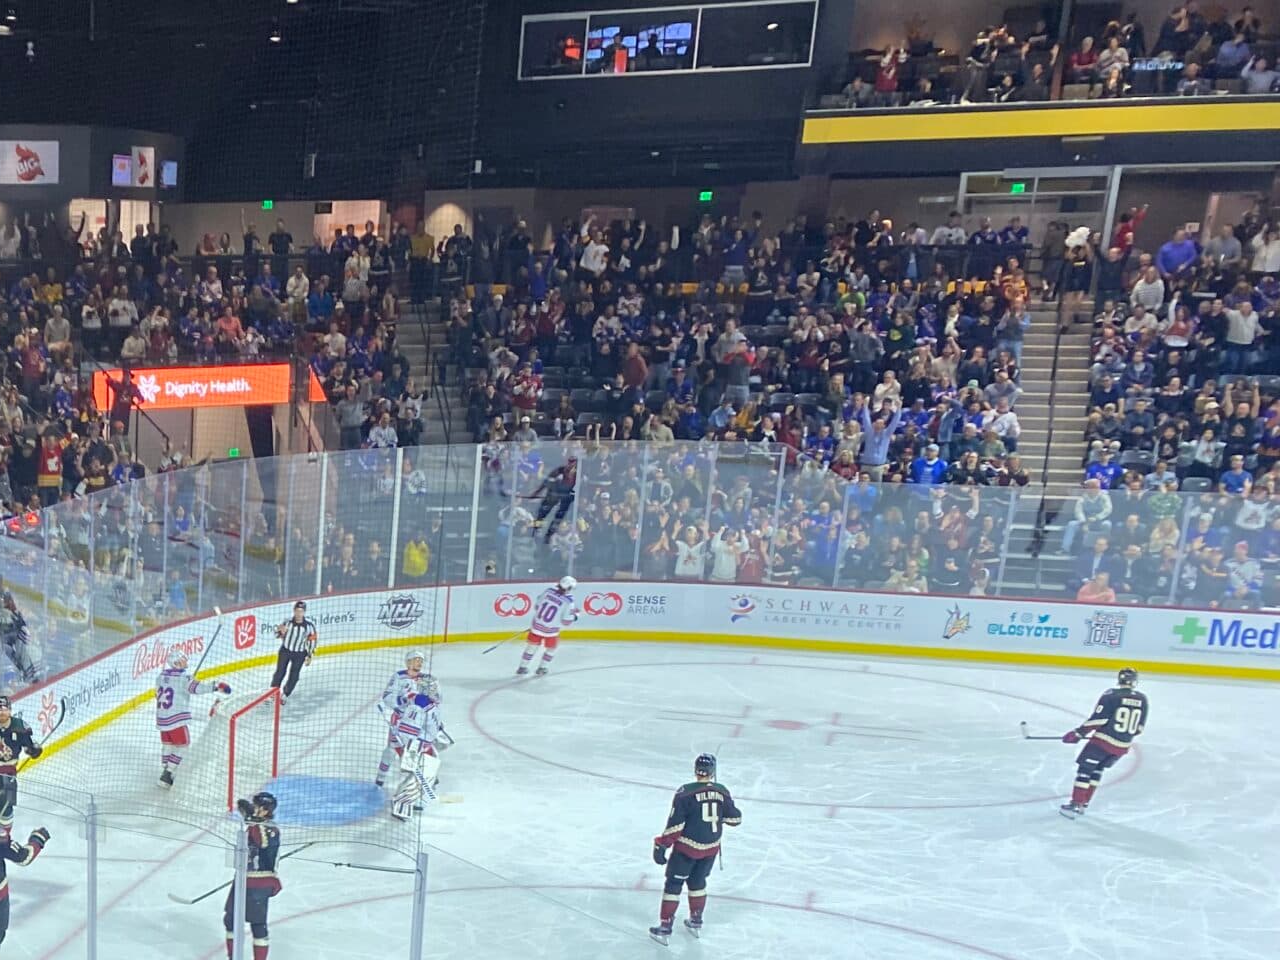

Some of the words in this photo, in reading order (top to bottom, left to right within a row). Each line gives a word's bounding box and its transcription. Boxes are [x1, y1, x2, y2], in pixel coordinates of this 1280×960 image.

[165, 380, 208, 398] Dignity
[377, 601, 424, 619] NHL
[627, 605, 666, 614] ARENA
[628, 595, 667, 605] SENSE
[765, 598, 905, 617] SCHWARTZ
[538, 601, 558, 623] 10
[764, 615, 807, 625] LASER
[815, 617, 839, 626] EYE
[847, 619, 902, 631] CENTER
[987, 623, 1069, 639] @LOSYOTES
[1208, 618, 1280, 649] Med
[132, 638, 170, 680] Bally
[93, 669, 120, 697] Health
[157, 687, 174, 710] 23
[1114, 707, 1141, 734] 90
[702, 802, 720, 833] 4
